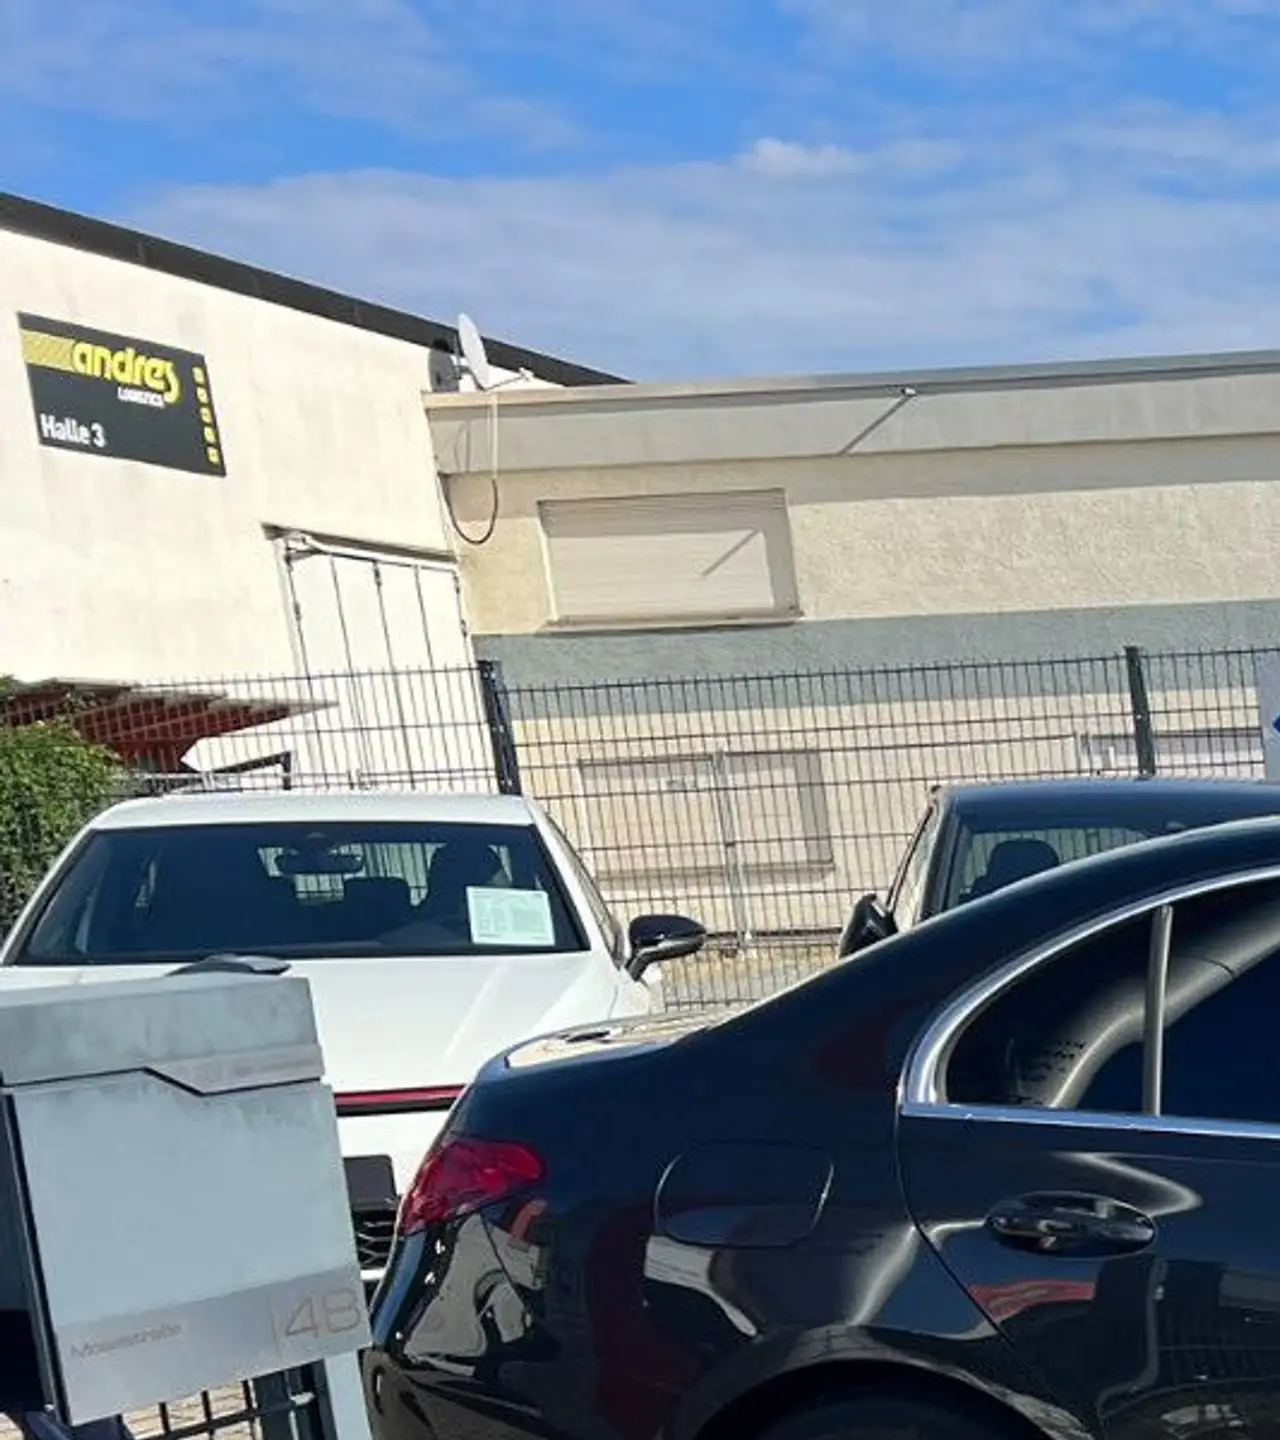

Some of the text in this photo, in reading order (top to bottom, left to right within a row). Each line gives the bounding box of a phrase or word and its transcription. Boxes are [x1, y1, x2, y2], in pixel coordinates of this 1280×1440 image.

[73, 341, 181, 404] andres
[39, 412, 106, 448] Halle 3
[285, 1286, 362, 1339] 48
